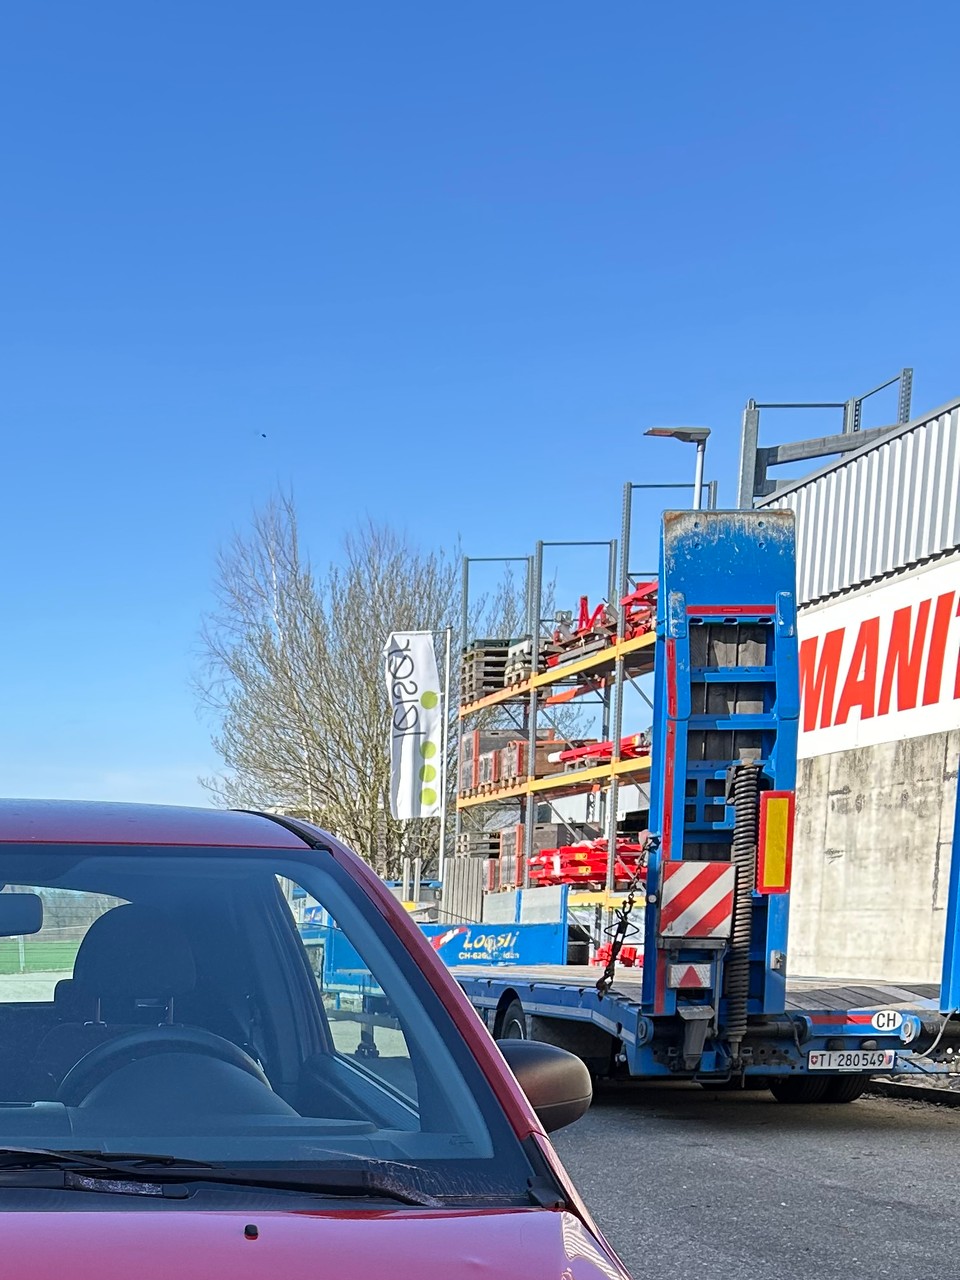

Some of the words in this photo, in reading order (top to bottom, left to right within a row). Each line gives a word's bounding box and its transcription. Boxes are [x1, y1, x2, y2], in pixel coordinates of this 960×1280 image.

[798, 590, 960, 733] MANI
[876, 1012, 897, 1028] CH
[819, 1053, 832, 1067] TI
[837, 1053, 885, 1067] 280549
